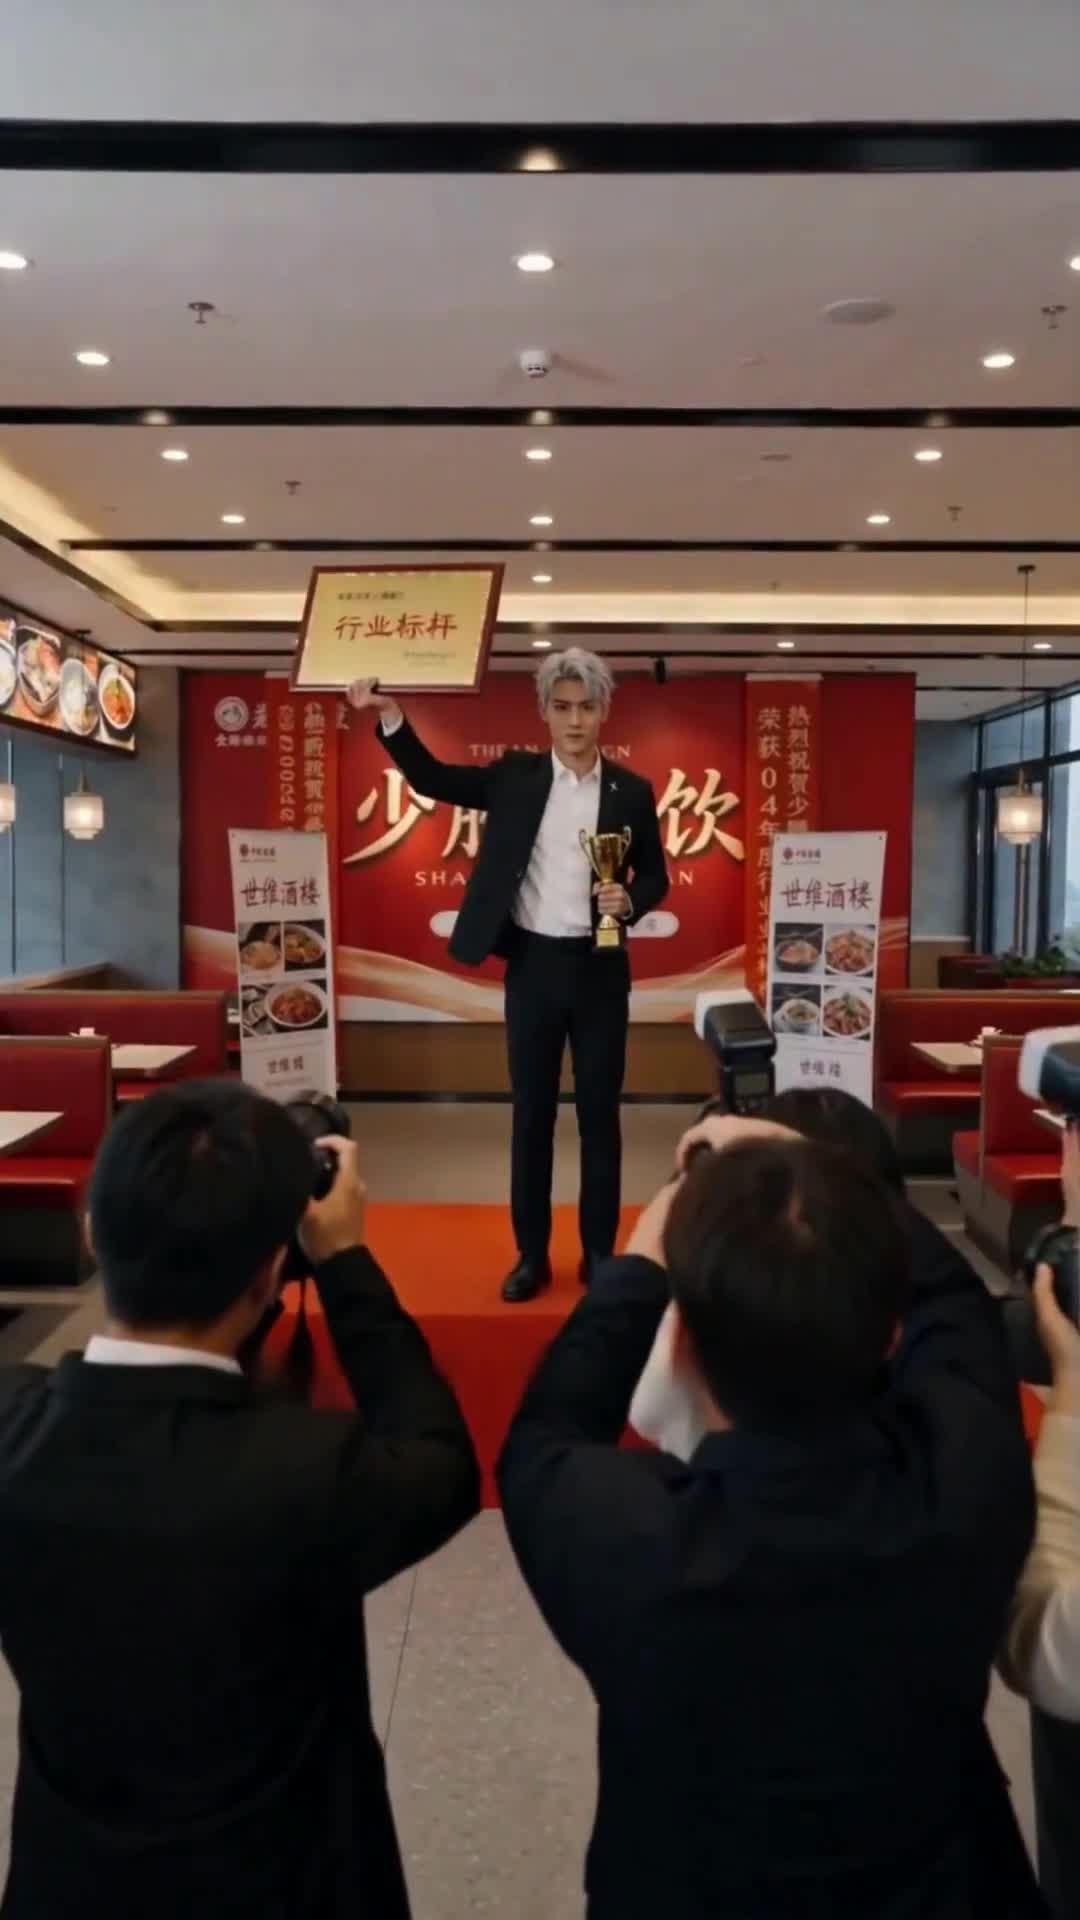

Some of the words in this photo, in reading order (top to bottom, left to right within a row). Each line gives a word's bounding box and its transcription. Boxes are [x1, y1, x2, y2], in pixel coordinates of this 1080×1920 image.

[336, 611, 457, 641] 行业标杆
[240, 876, 321, 908] 世维酒楼
[781, 876, 873, 911] 世维酒楼
